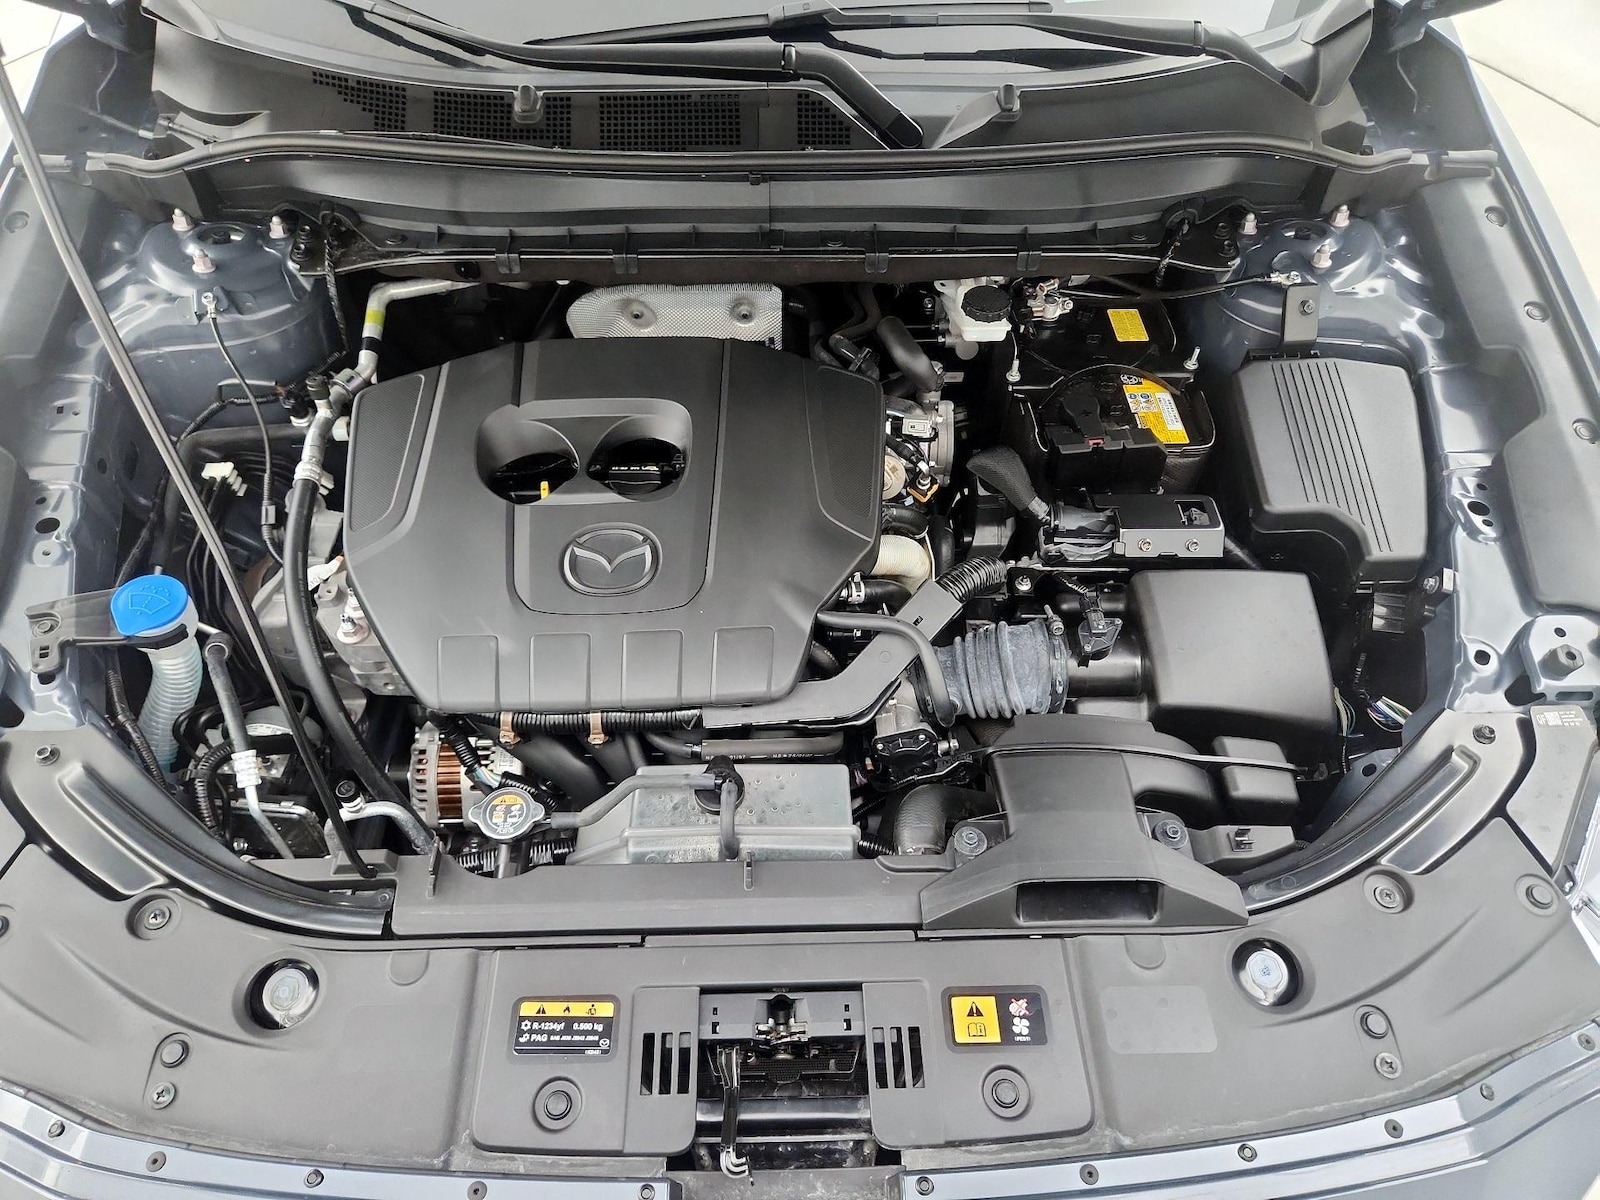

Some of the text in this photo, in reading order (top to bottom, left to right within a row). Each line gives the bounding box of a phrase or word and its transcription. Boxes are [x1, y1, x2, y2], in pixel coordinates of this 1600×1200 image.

[532, 1021, 604, 1032] R-1234yf 0.500 kg
[530, 1033, 548, 1042] PAG
